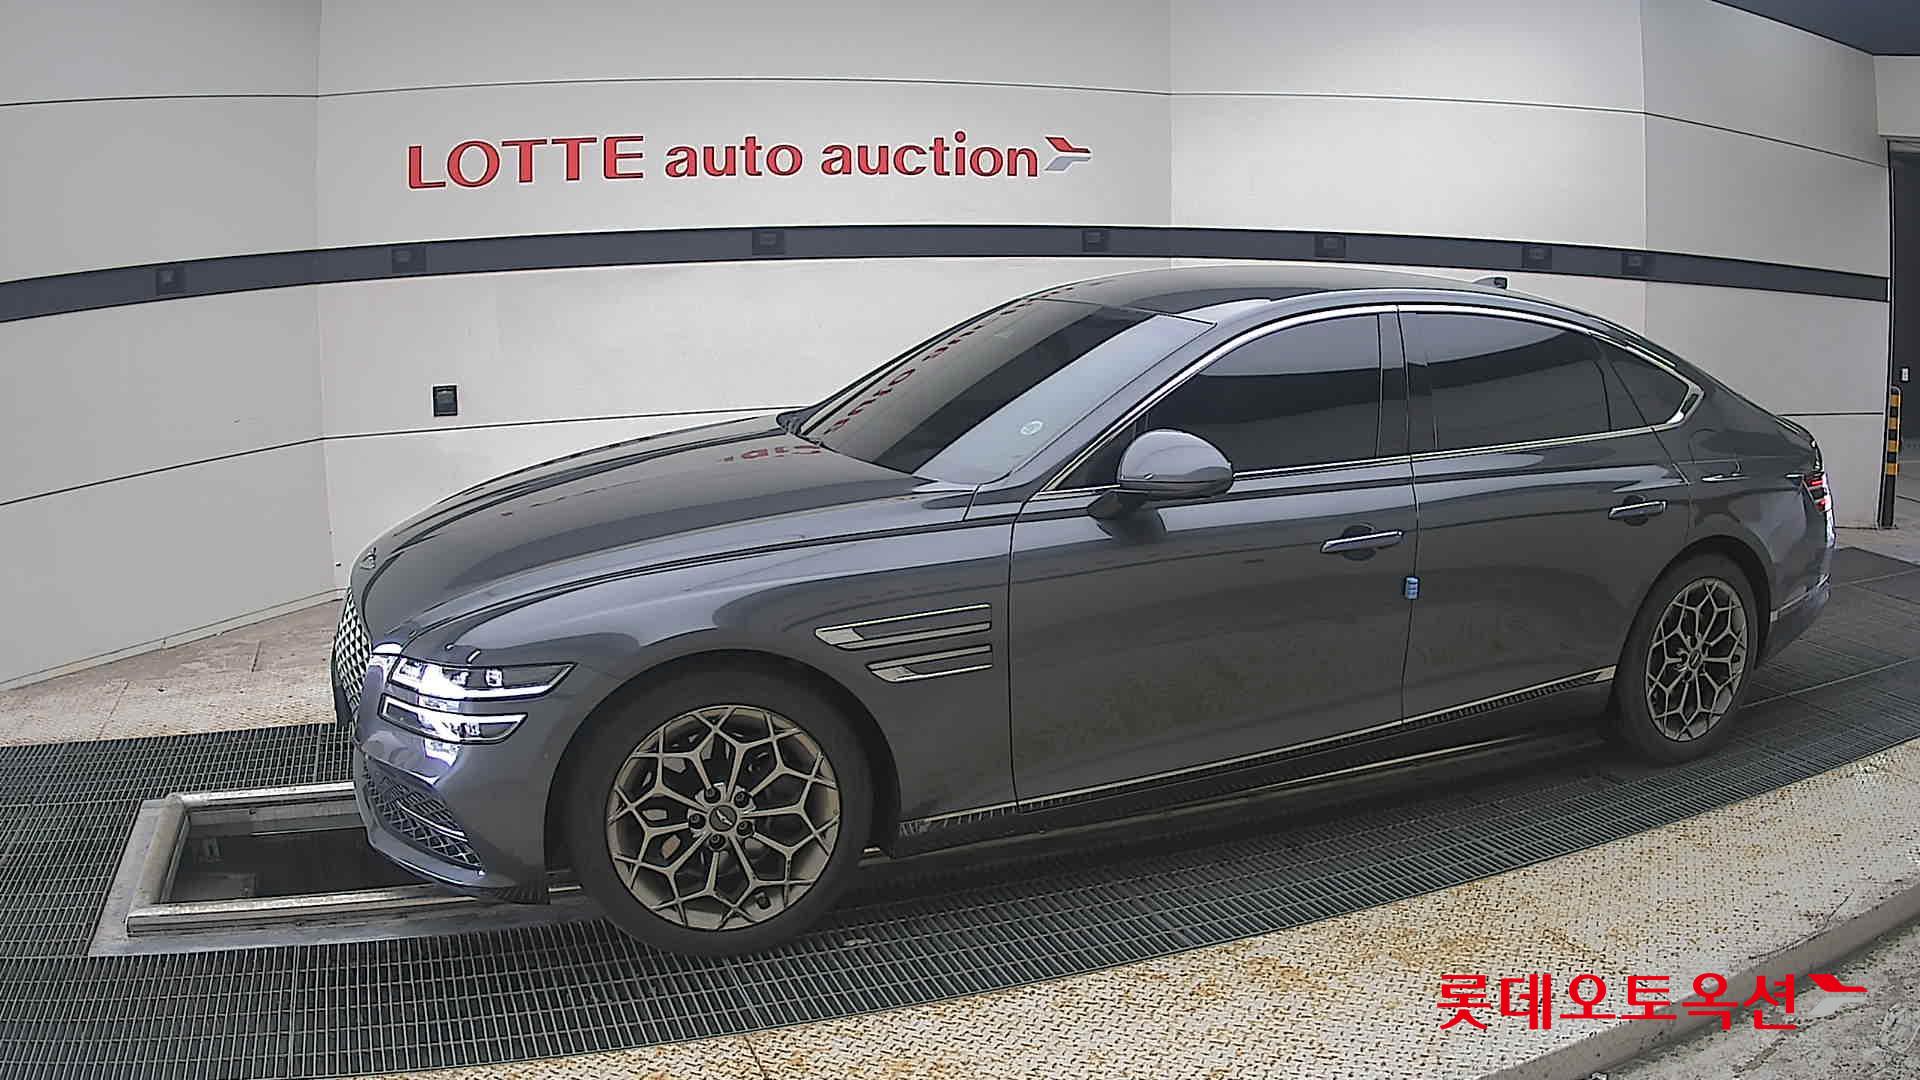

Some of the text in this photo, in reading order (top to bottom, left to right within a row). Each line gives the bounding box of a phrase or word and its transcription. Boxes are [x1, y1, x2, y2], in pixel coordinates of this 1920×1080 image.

[407, 130, 1039, 190] LOTTE auto auction
